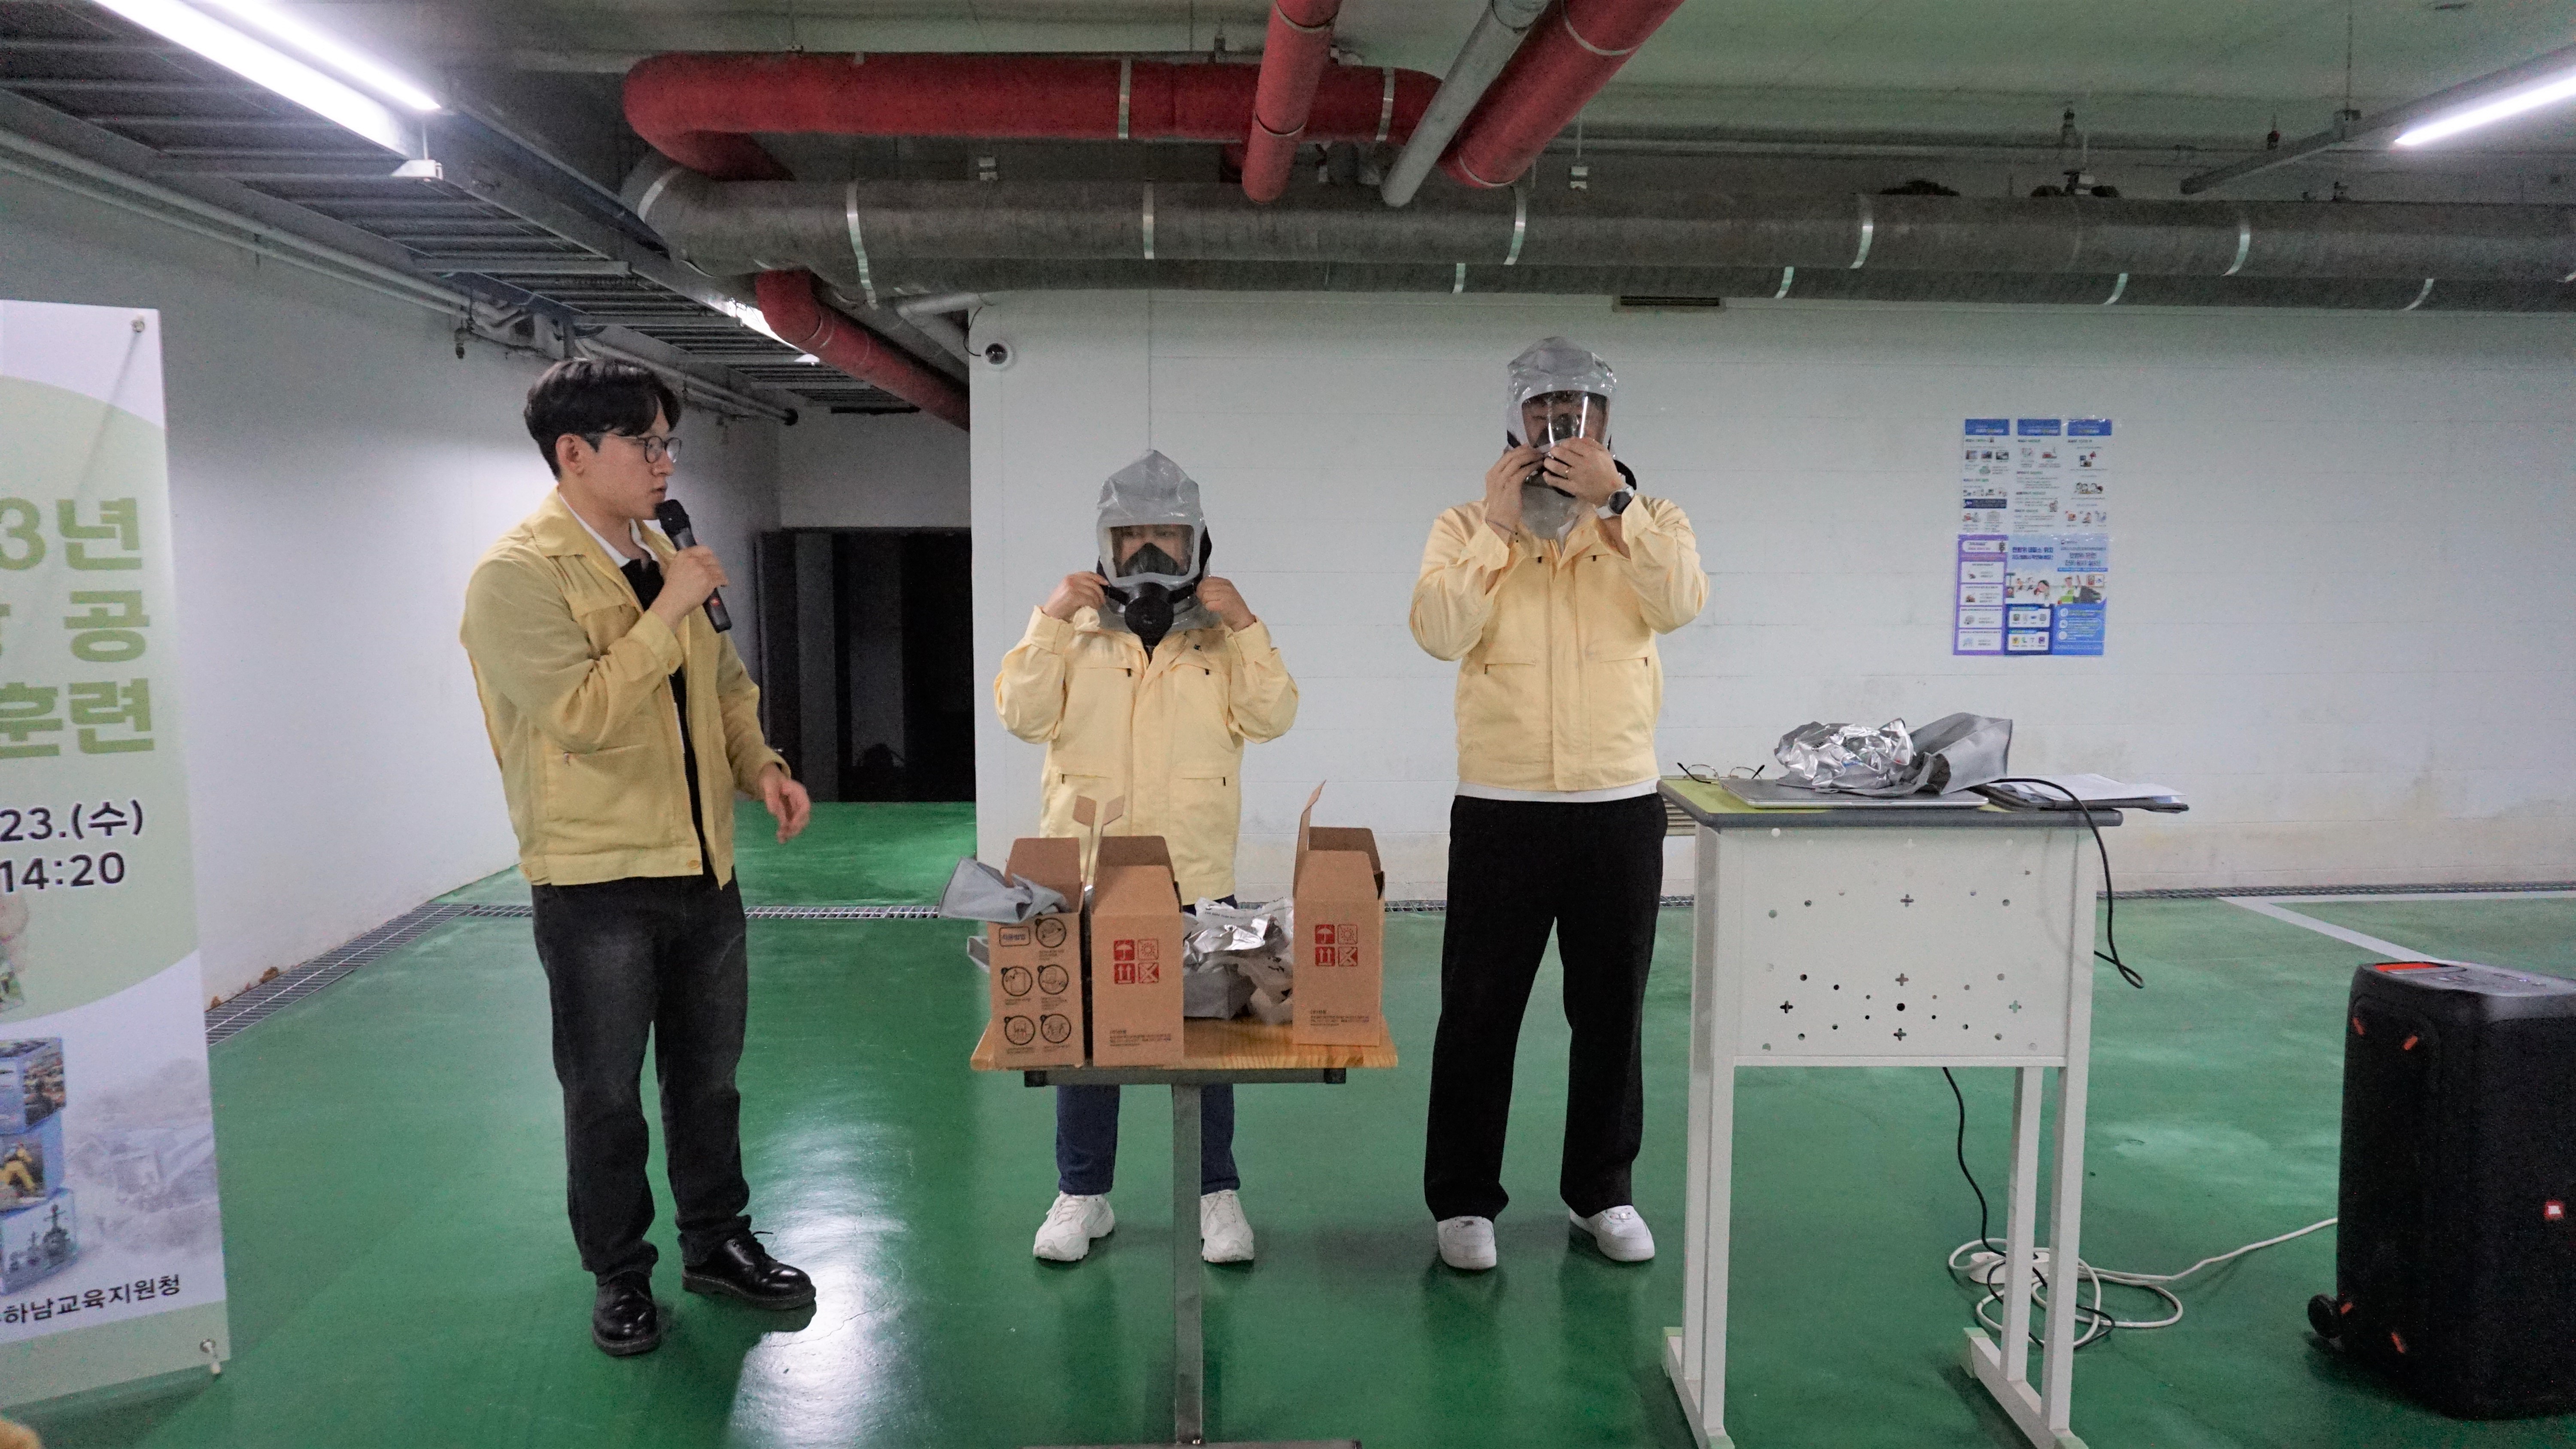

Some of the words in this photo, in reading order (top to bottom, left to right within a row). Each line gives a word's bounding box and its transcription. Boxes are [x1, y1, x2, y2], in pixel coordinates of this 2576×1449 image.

[0, 497, 142, 570] 3년
[63, 590, 150, 662] 공
[0, 678, 155, 759] 훈련
[0, 800, 143, 842] 23.(수)
[0, 852, 125, 893] 14:20
[0, 1274, 180, 1324] 하남교육지원청
